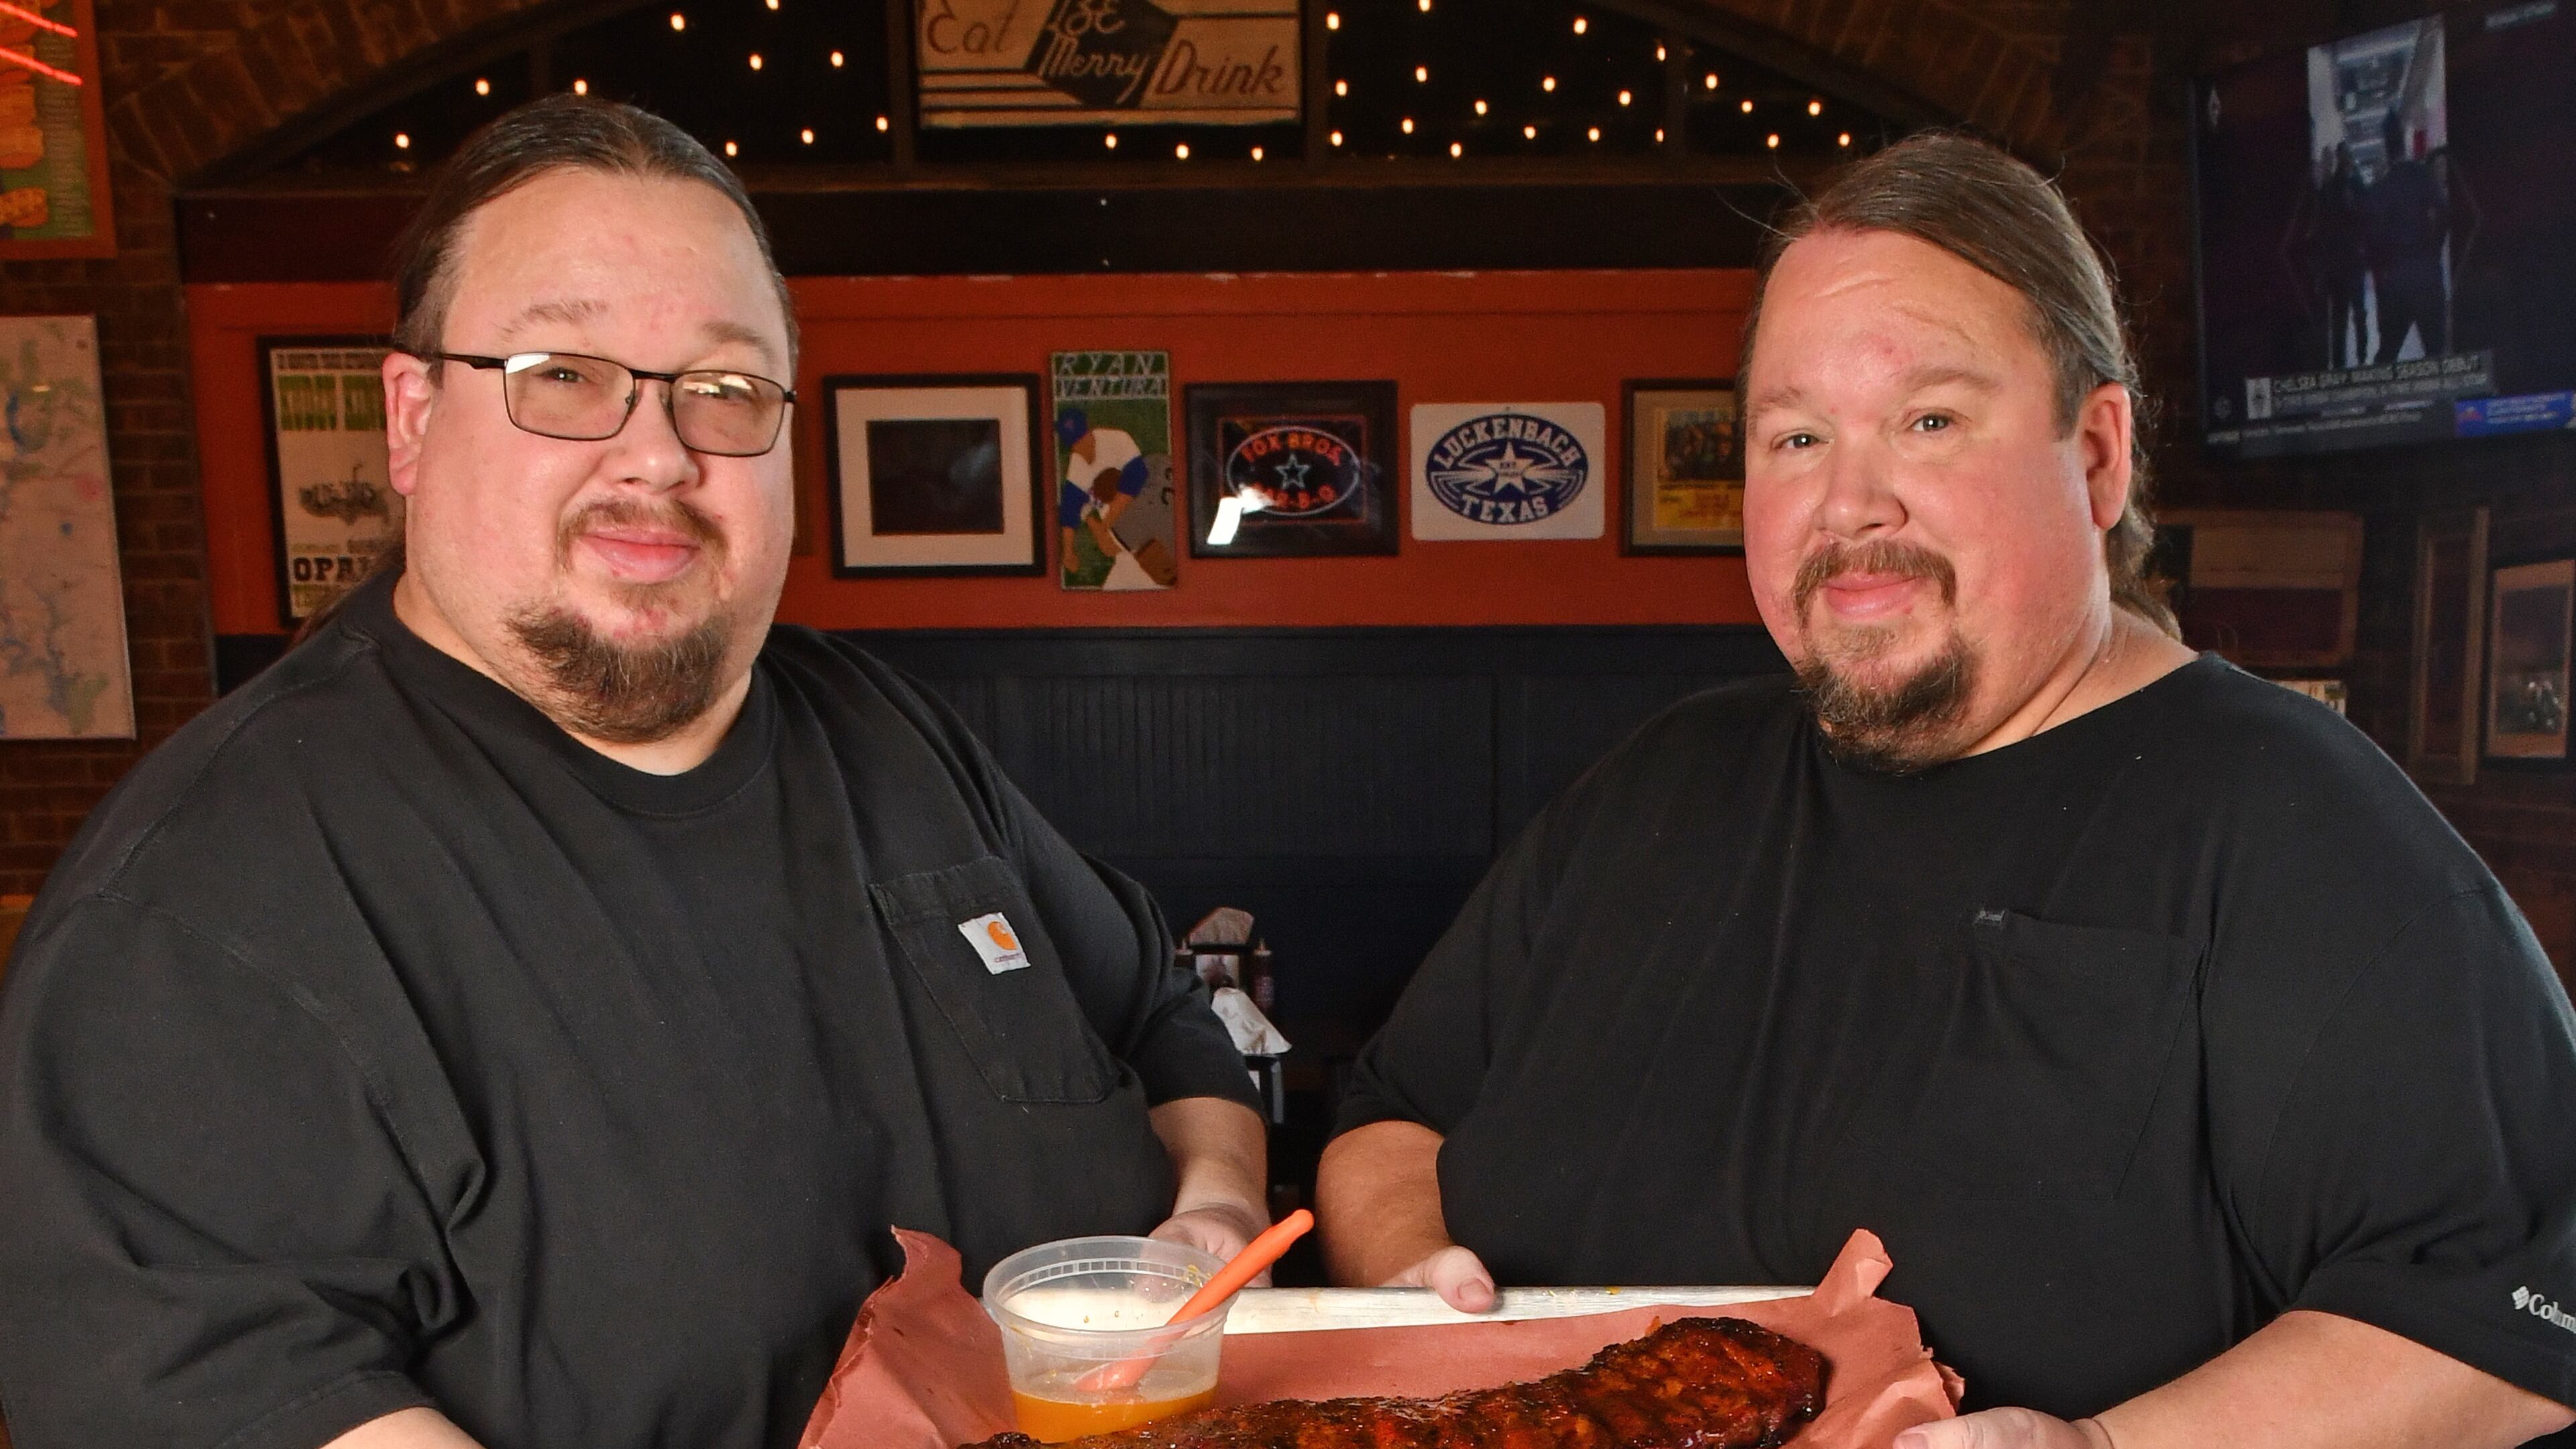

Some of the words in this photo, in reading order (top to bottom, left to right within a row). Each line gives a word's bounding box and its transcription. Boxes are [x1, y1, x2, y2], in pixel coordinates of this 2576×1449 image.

[1038, 32, 1151, 105] Merry
[1155, 38, 1285, 95] Drink
[1057, 353, 1156, 377] RYAN
[1057, 376, 1163, 397] VENTURA
[1241, 433, 1282, 463] FOX
[1434, 417, 1582, 470] LUCKENBACH
[1462, 495, 1550, 523] TEXAS
